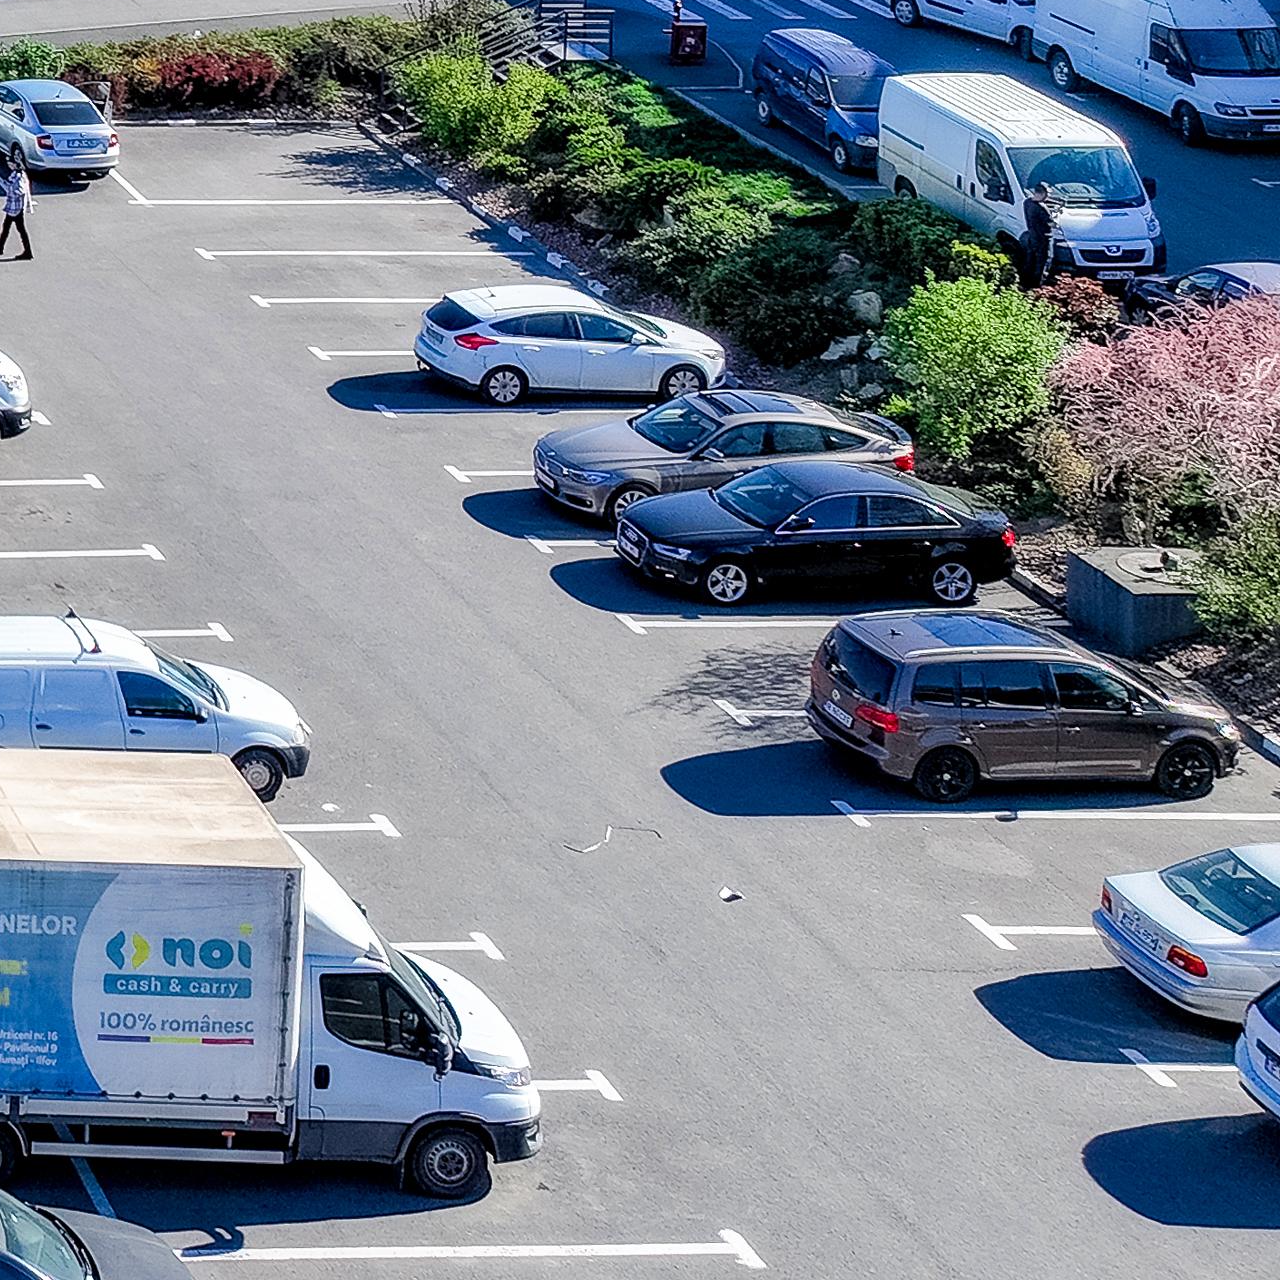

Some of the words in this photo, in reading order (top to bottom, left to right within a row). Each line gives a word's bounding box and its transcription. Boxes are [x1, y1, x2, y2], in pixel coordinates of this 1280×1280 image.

[162, 923, 253, 969] noi
[116, 977, 162, 993] cash
[168, 978, 183, 993] &
[189, 980, 239, 998] carry
[100, 1011, 157, 1032] 100%
[160, 1014, 255, 1035] românesc
